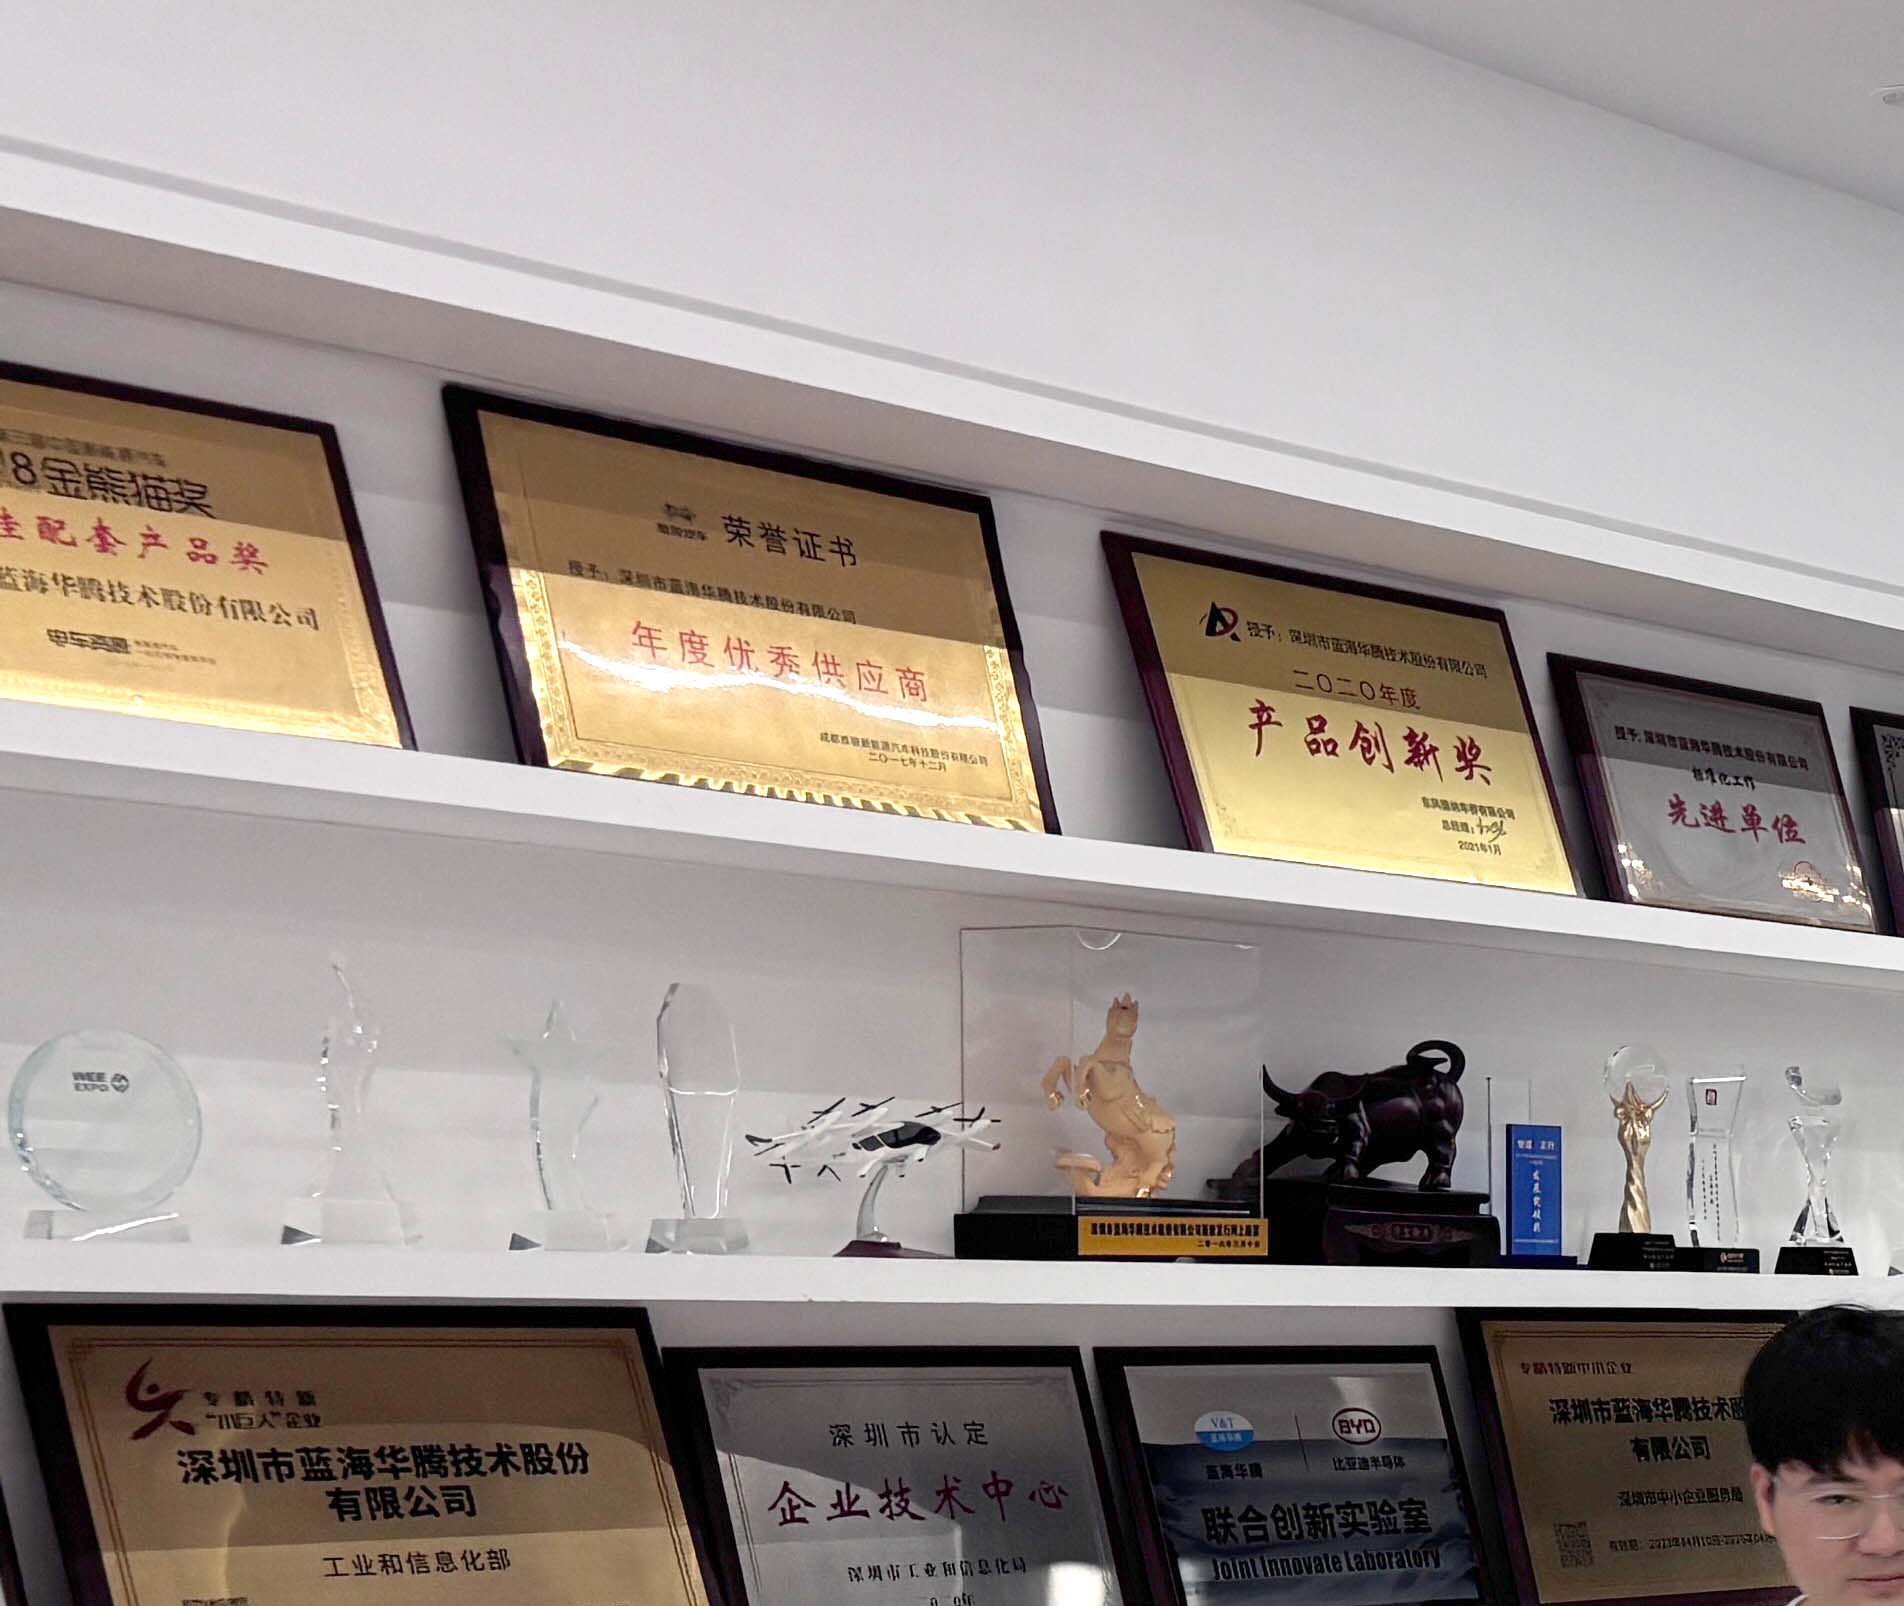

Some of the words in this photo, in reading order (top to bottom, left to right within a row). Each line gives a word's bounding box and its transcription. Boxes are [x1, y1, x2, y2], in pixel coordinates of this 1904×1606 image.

[721, 514, 858, 568] 荣誉证书
[632, 620, 927, 702] 年度优秀供应商
[1248, 698, 1493, 786] 产品创新奖
[1667, 792, 1806, 844] 先进单位
[828, 1422, 990, 1448] 深圳市认定
[1338, 1417, 1377, 1436] BYD
[1630, 1435, 1712, 1463] 有限公司
[177, 1441, 590, 1486] 深圳市蓝海华腾技术股份
[326, 1484, 478, 1523] 有限公司
[767, 1470, 1070, 1527] 企业技术中心
[1201, 1499, 1433, 1544] 联合创新实验室
[322, 1549, 512, 1579] 工业和信息化部
[1213, 1554, 1260, 1581] Joint
[1262, 1552, 1344, 1578] Innovate
[1346, 1548, 1441, 1572] Laboratory
